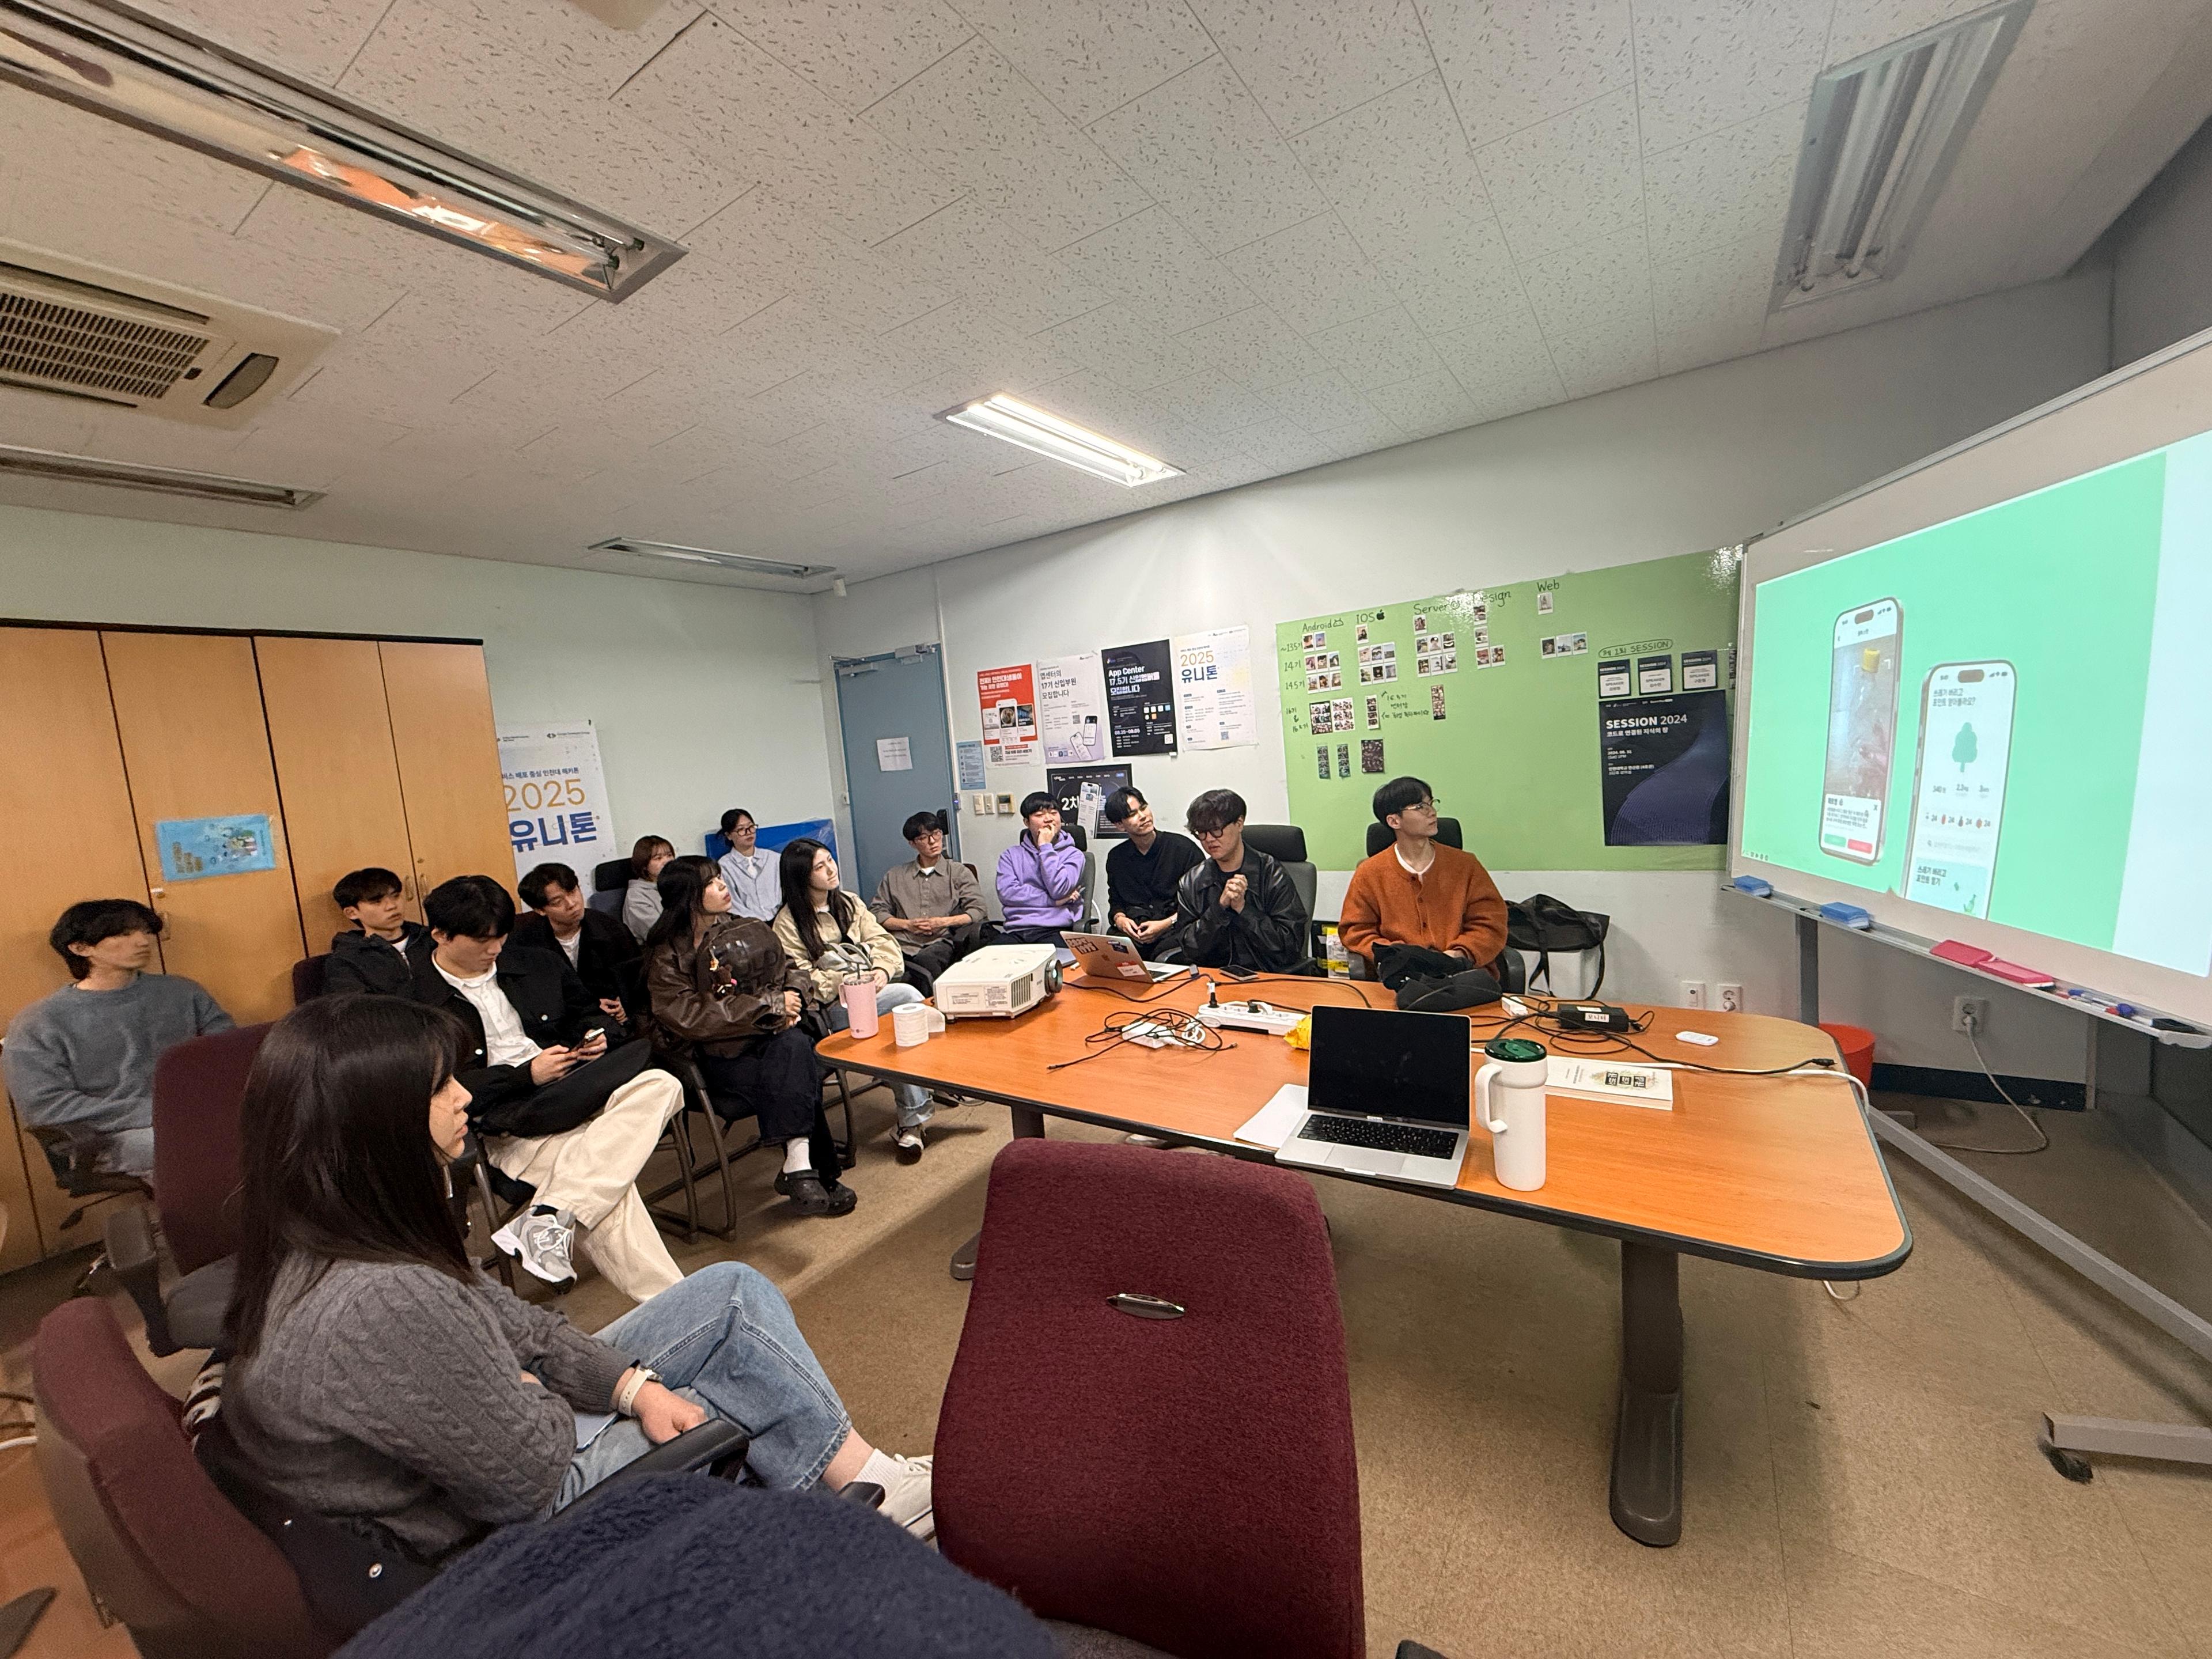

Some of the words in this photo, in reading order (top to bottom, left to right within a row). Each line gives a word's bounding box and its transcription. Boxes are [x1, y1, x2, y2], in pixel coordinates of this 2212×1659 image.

[1537, 579, 1560, 592] Web
[1473, 590, 1512, 608] Design
[1413, 603, 1448, 615] Server
[1356, 612, 1376, 624] iOS
[1302, 619, 1332, 632] Android
[1630, 641, 1669, 653] SESSION
[1180, 650, 1214, 666] 2025
[1108, 669, 1122, 678] App
[1122, 665, 1145, 675] Center
[1181, 665, 1218, 684] 유니톤
[1041, 680, 1053, 690] 17기
[1054, 677, 1077, 688] 신입부원
[1109, 676, 1128, 686] 17.5기
[1042, 689, 1069, 699] 모집합니다
[1110, 684, 1141, 696] 모집합니다
[1605, 716, 1658, 729] SESSION
[1660, 714, 1688, 725] 2024
[529, 770, 542, 778] 중심
[543, 768, 561, 777] 인천대
[503, 778, 586, 812] 2025
[509, 811, 597, 853] 유니톤
